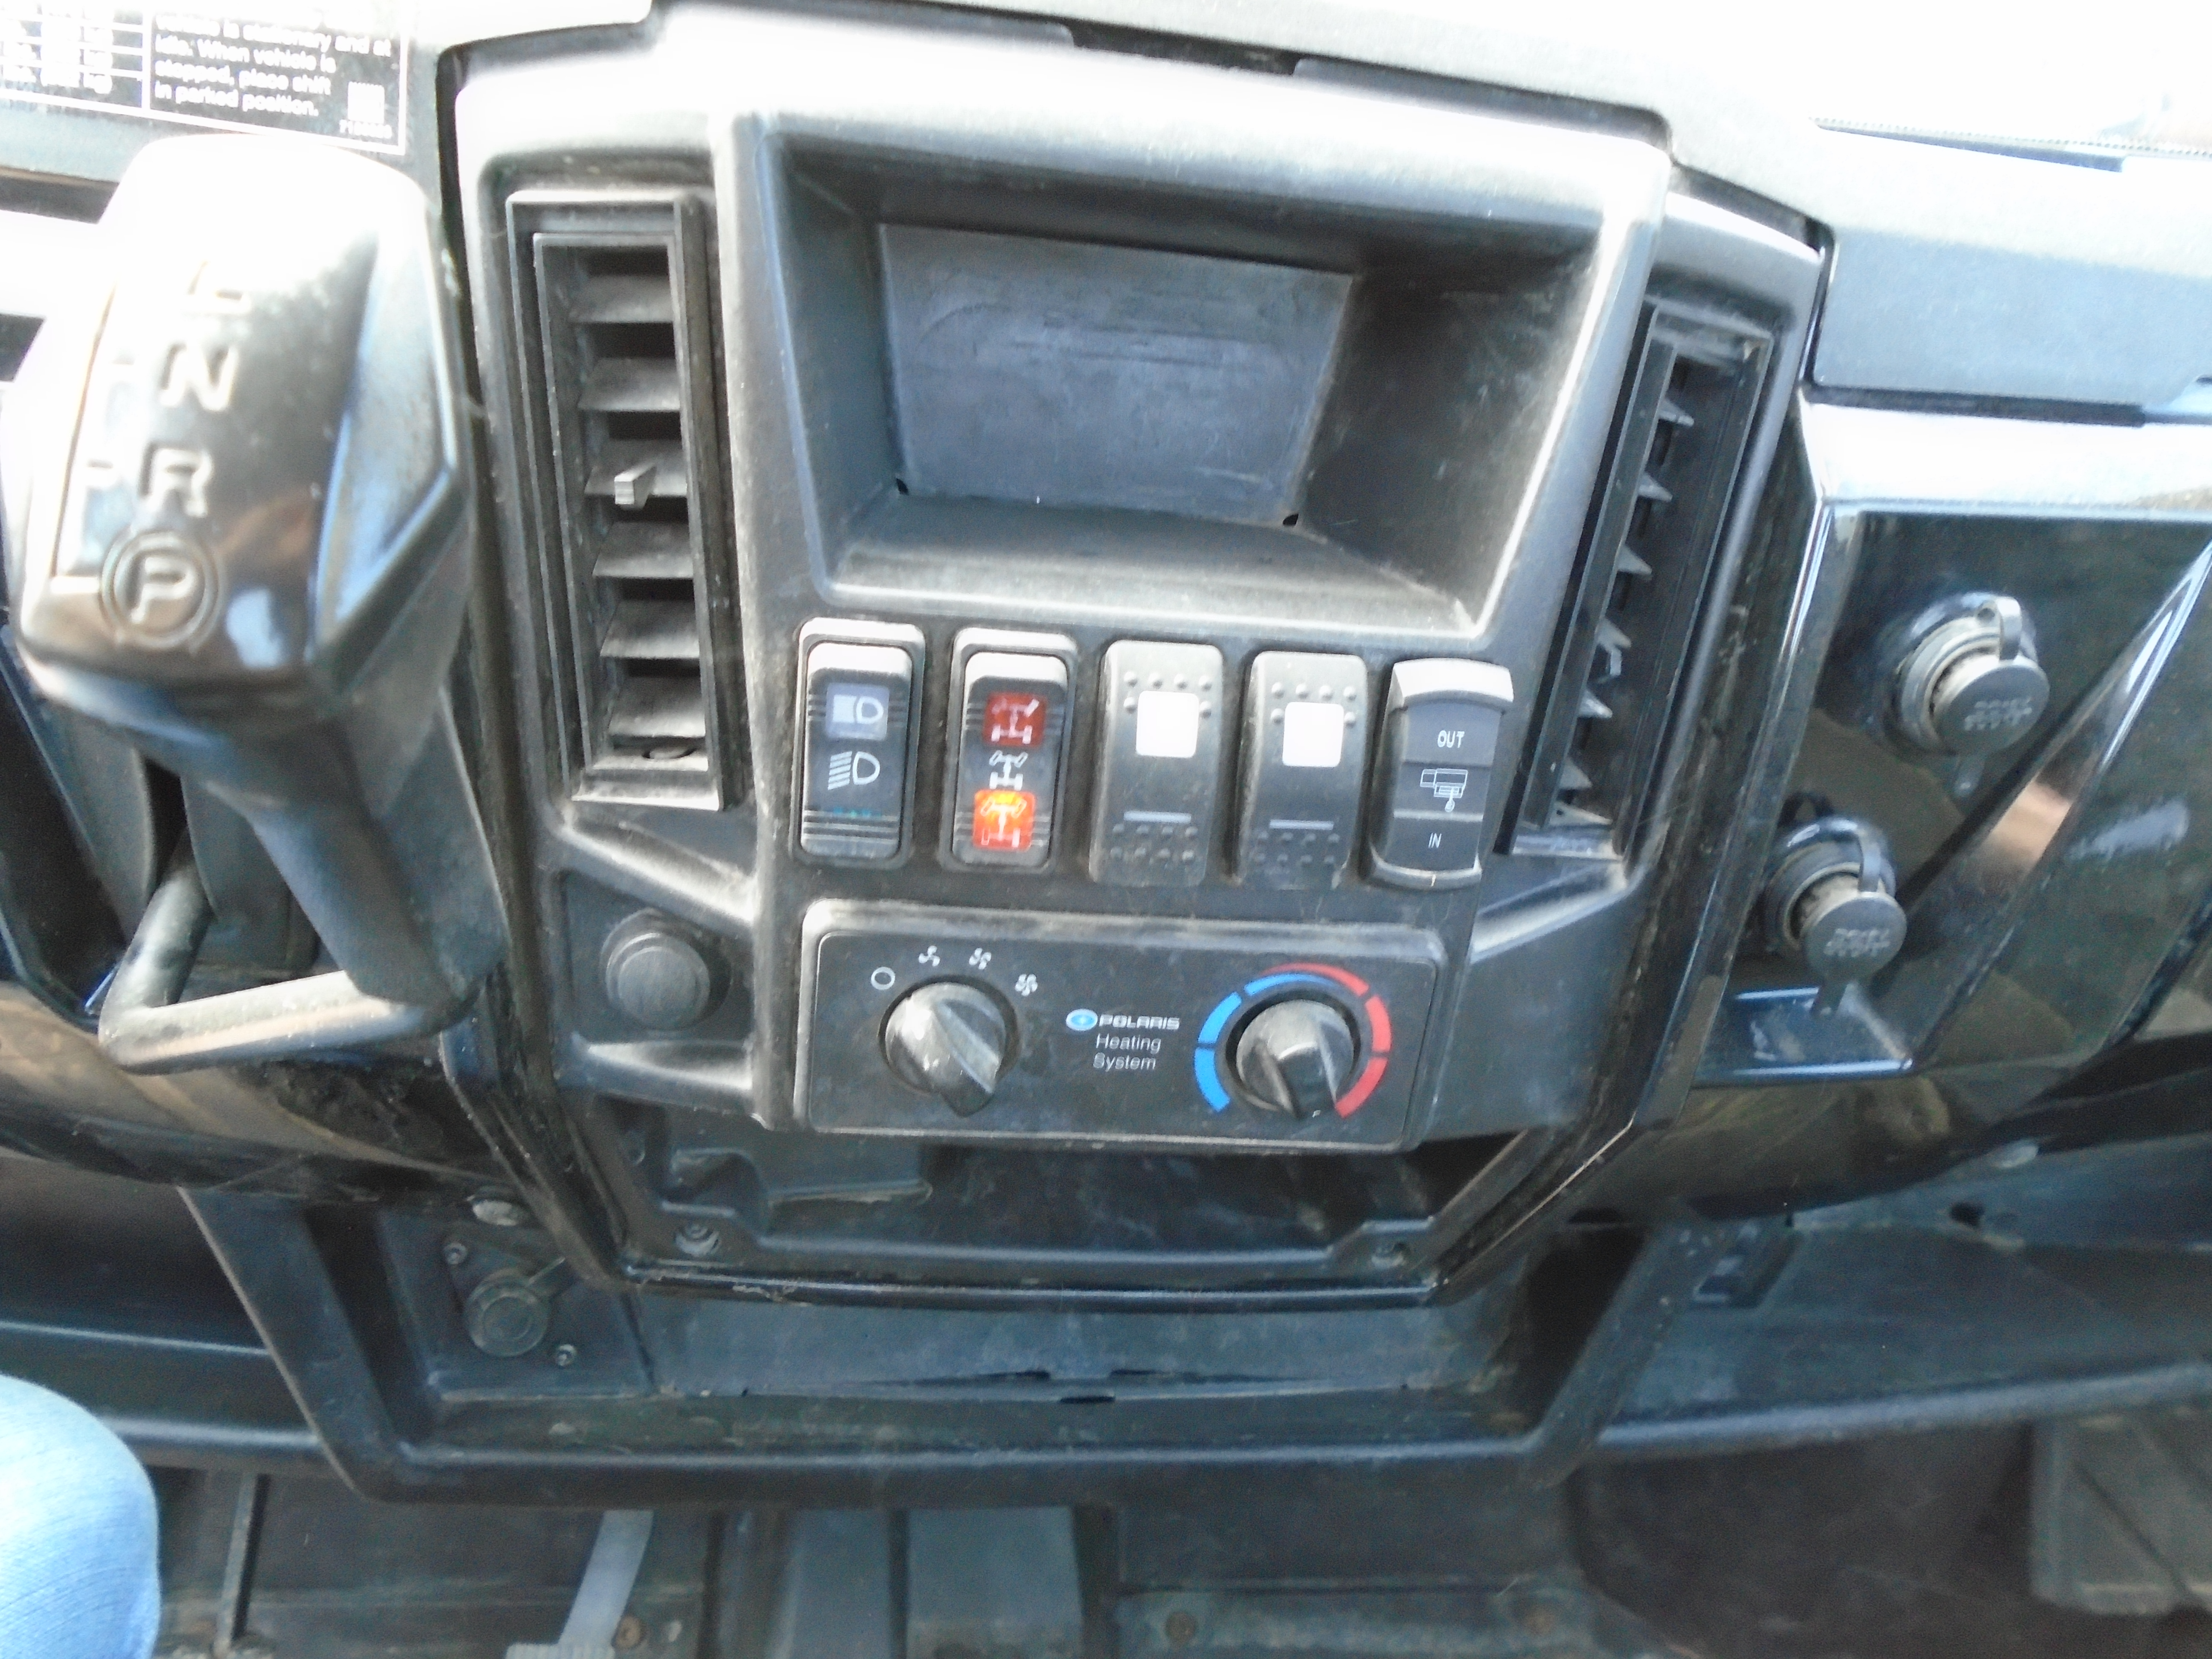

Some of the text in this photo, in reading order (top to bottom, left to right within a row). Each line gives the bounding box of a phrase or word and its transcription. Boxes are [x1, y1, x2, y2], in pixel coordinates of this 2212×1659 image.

[197, 38, 250, 63] When
[253, 48, 317, 70] vehicle
[335, 34, 370, 54] and
[373, 38, 391, 58] at
[239, 68, 289, 91] place
[292, 74, 331, 95] shift
[155, 80, 319, 117] in parked position.
[159, 341, 239, 411] N
[139, 441, 213, 518] R
[124, 548, 198, 623] P
[1437, 730, 1465, 748] OUT
[1428, 832, 1442, 849] IN
[1099, 1014, 1180, 1030] POLARIS
[1095, 1033, 1161, 1054] Heating
[1093, 1052, 1156, 1072] System
